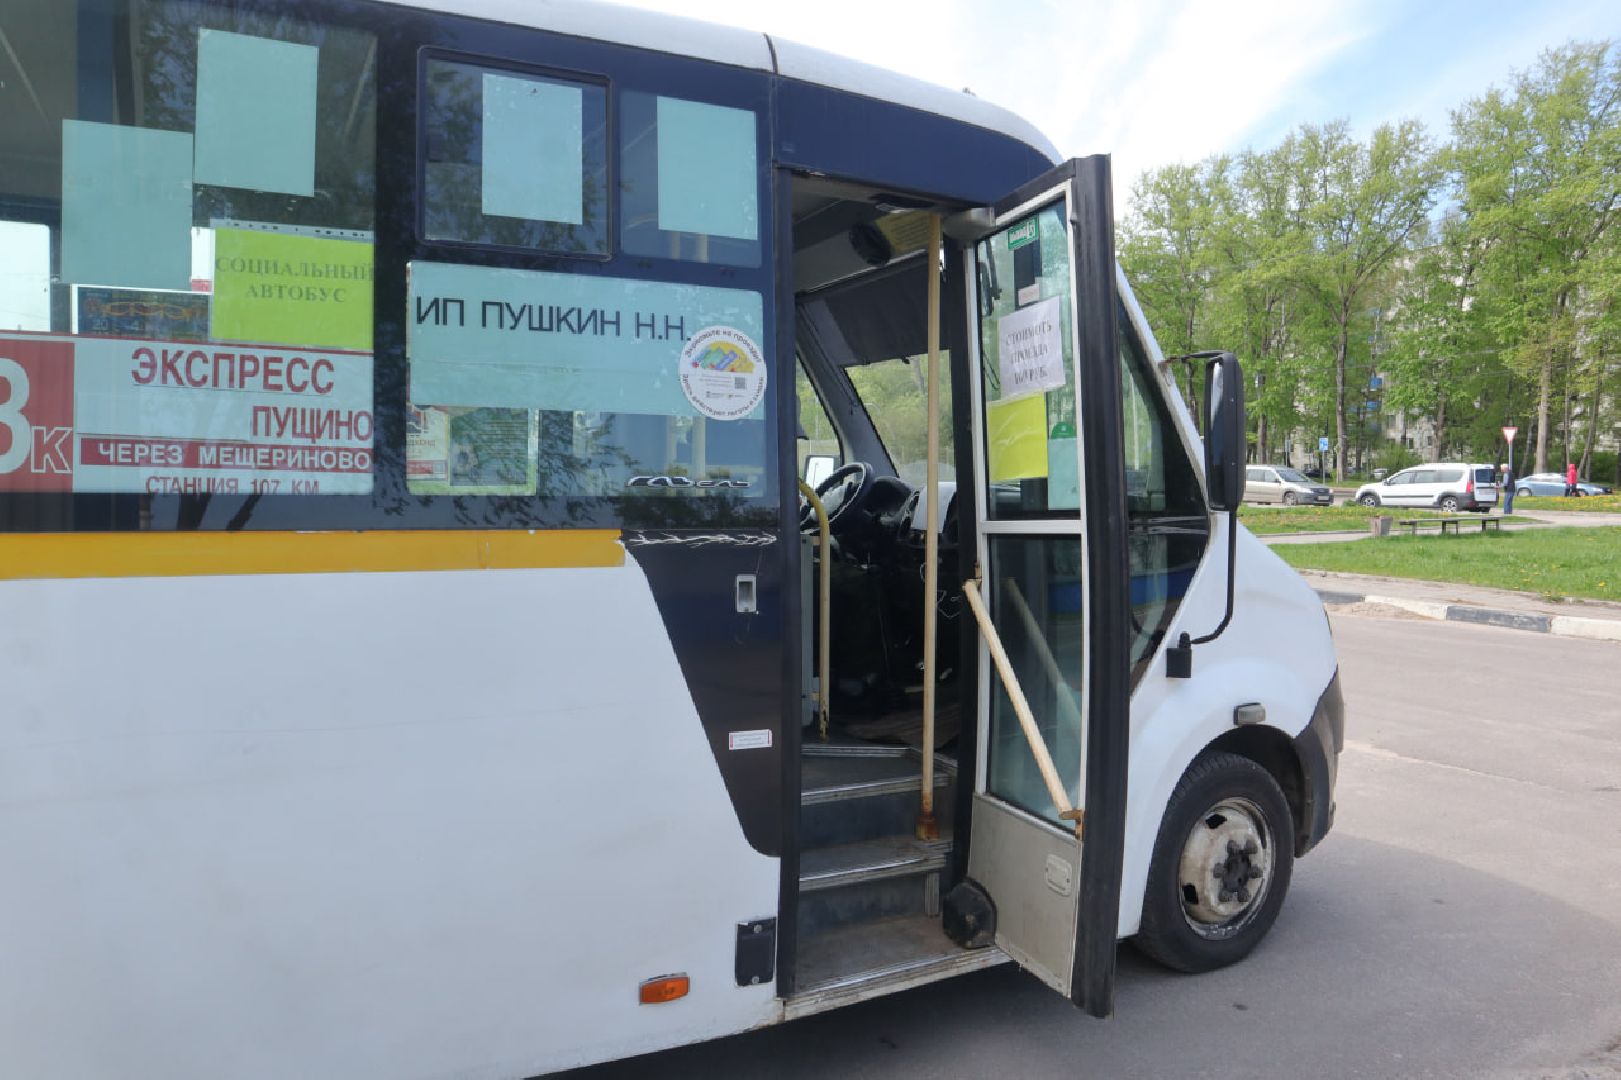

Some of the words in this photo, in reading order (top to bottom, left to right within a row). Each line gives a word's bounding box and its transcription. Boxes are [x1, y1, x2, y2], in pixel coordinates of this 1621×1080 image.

[215, 257, 374, 282] СОЦИАЛЬНЫЙ
[246, 283, 347, 303] АВТОБУС
[416, 296, 465, 327] ИП
[481, 301, 621, 337] ПУШКИН
[131, 347, 335, 394] ЭКСПРЕСС
[252, 405, 373, 444] ПУЩИНО
[98, 443, 183, 465] ЧЕРЕЗ
[198, 446, 371, 471] МЕЩЕРИНОВО
[145, 475, 239, 495] СТАНЦИЯ
[250, 479, 281, 495] 107
[291, 479, 320, 495] КМ
